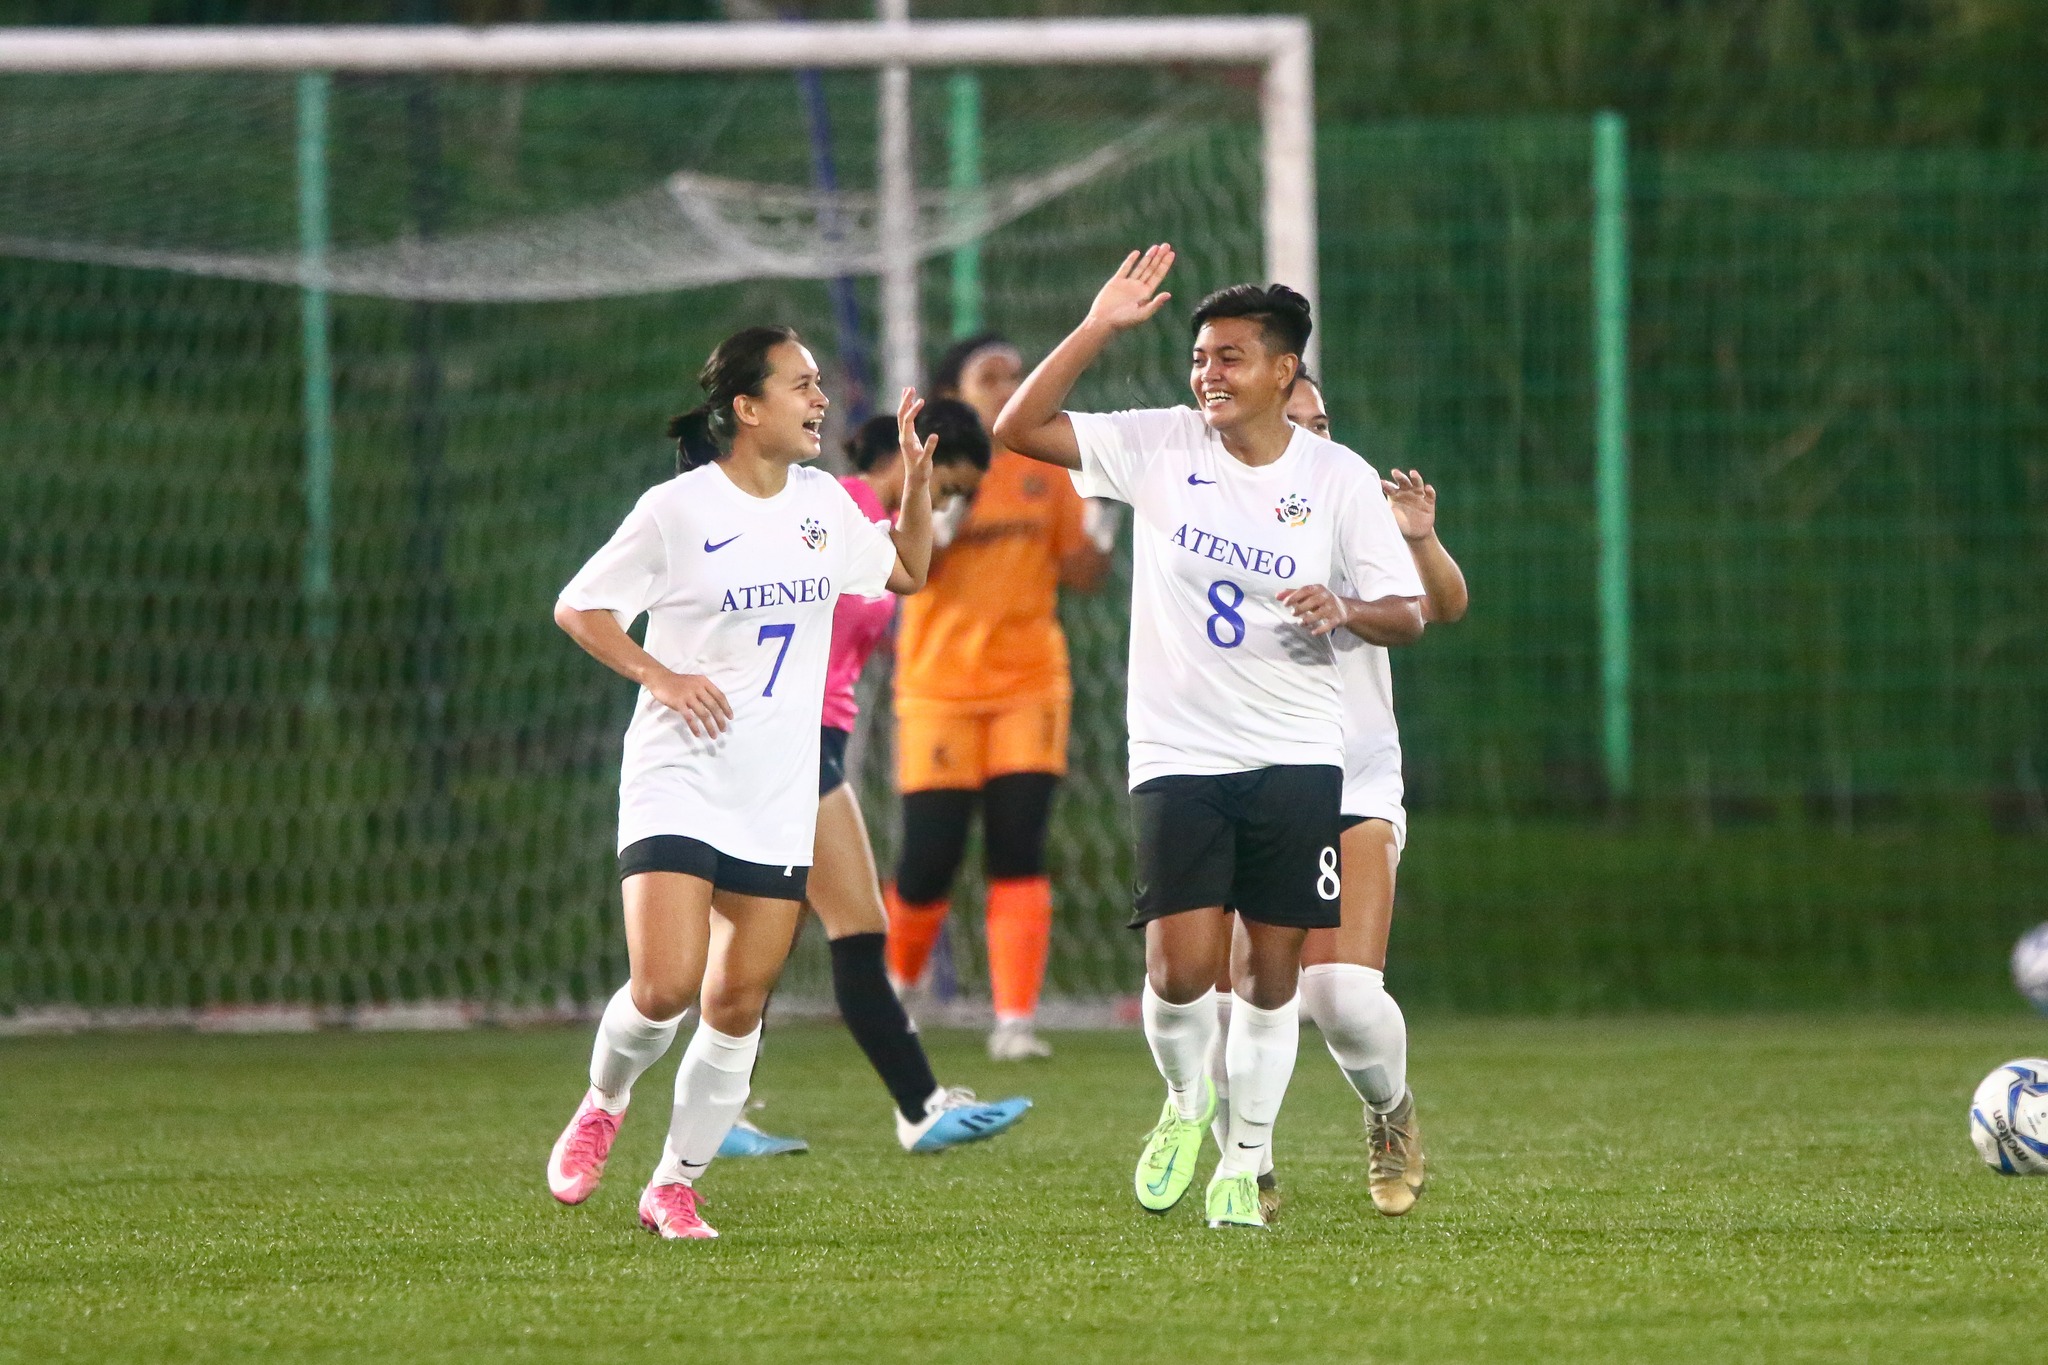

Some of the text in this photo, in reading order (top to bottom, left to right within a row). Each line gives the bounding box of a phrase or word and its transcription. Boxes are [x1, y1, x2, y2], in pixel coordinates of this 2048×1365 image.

[1171, 523, 1296, 579] ATENEO
[720, 576, 831, 612] ATENEO
[1206, 579, 1246, 649] 8
[757, 623, 796, 698] 7
[1316, 846, 1341, 901] 8
[1992, 1109, 2030, 1162] molten
